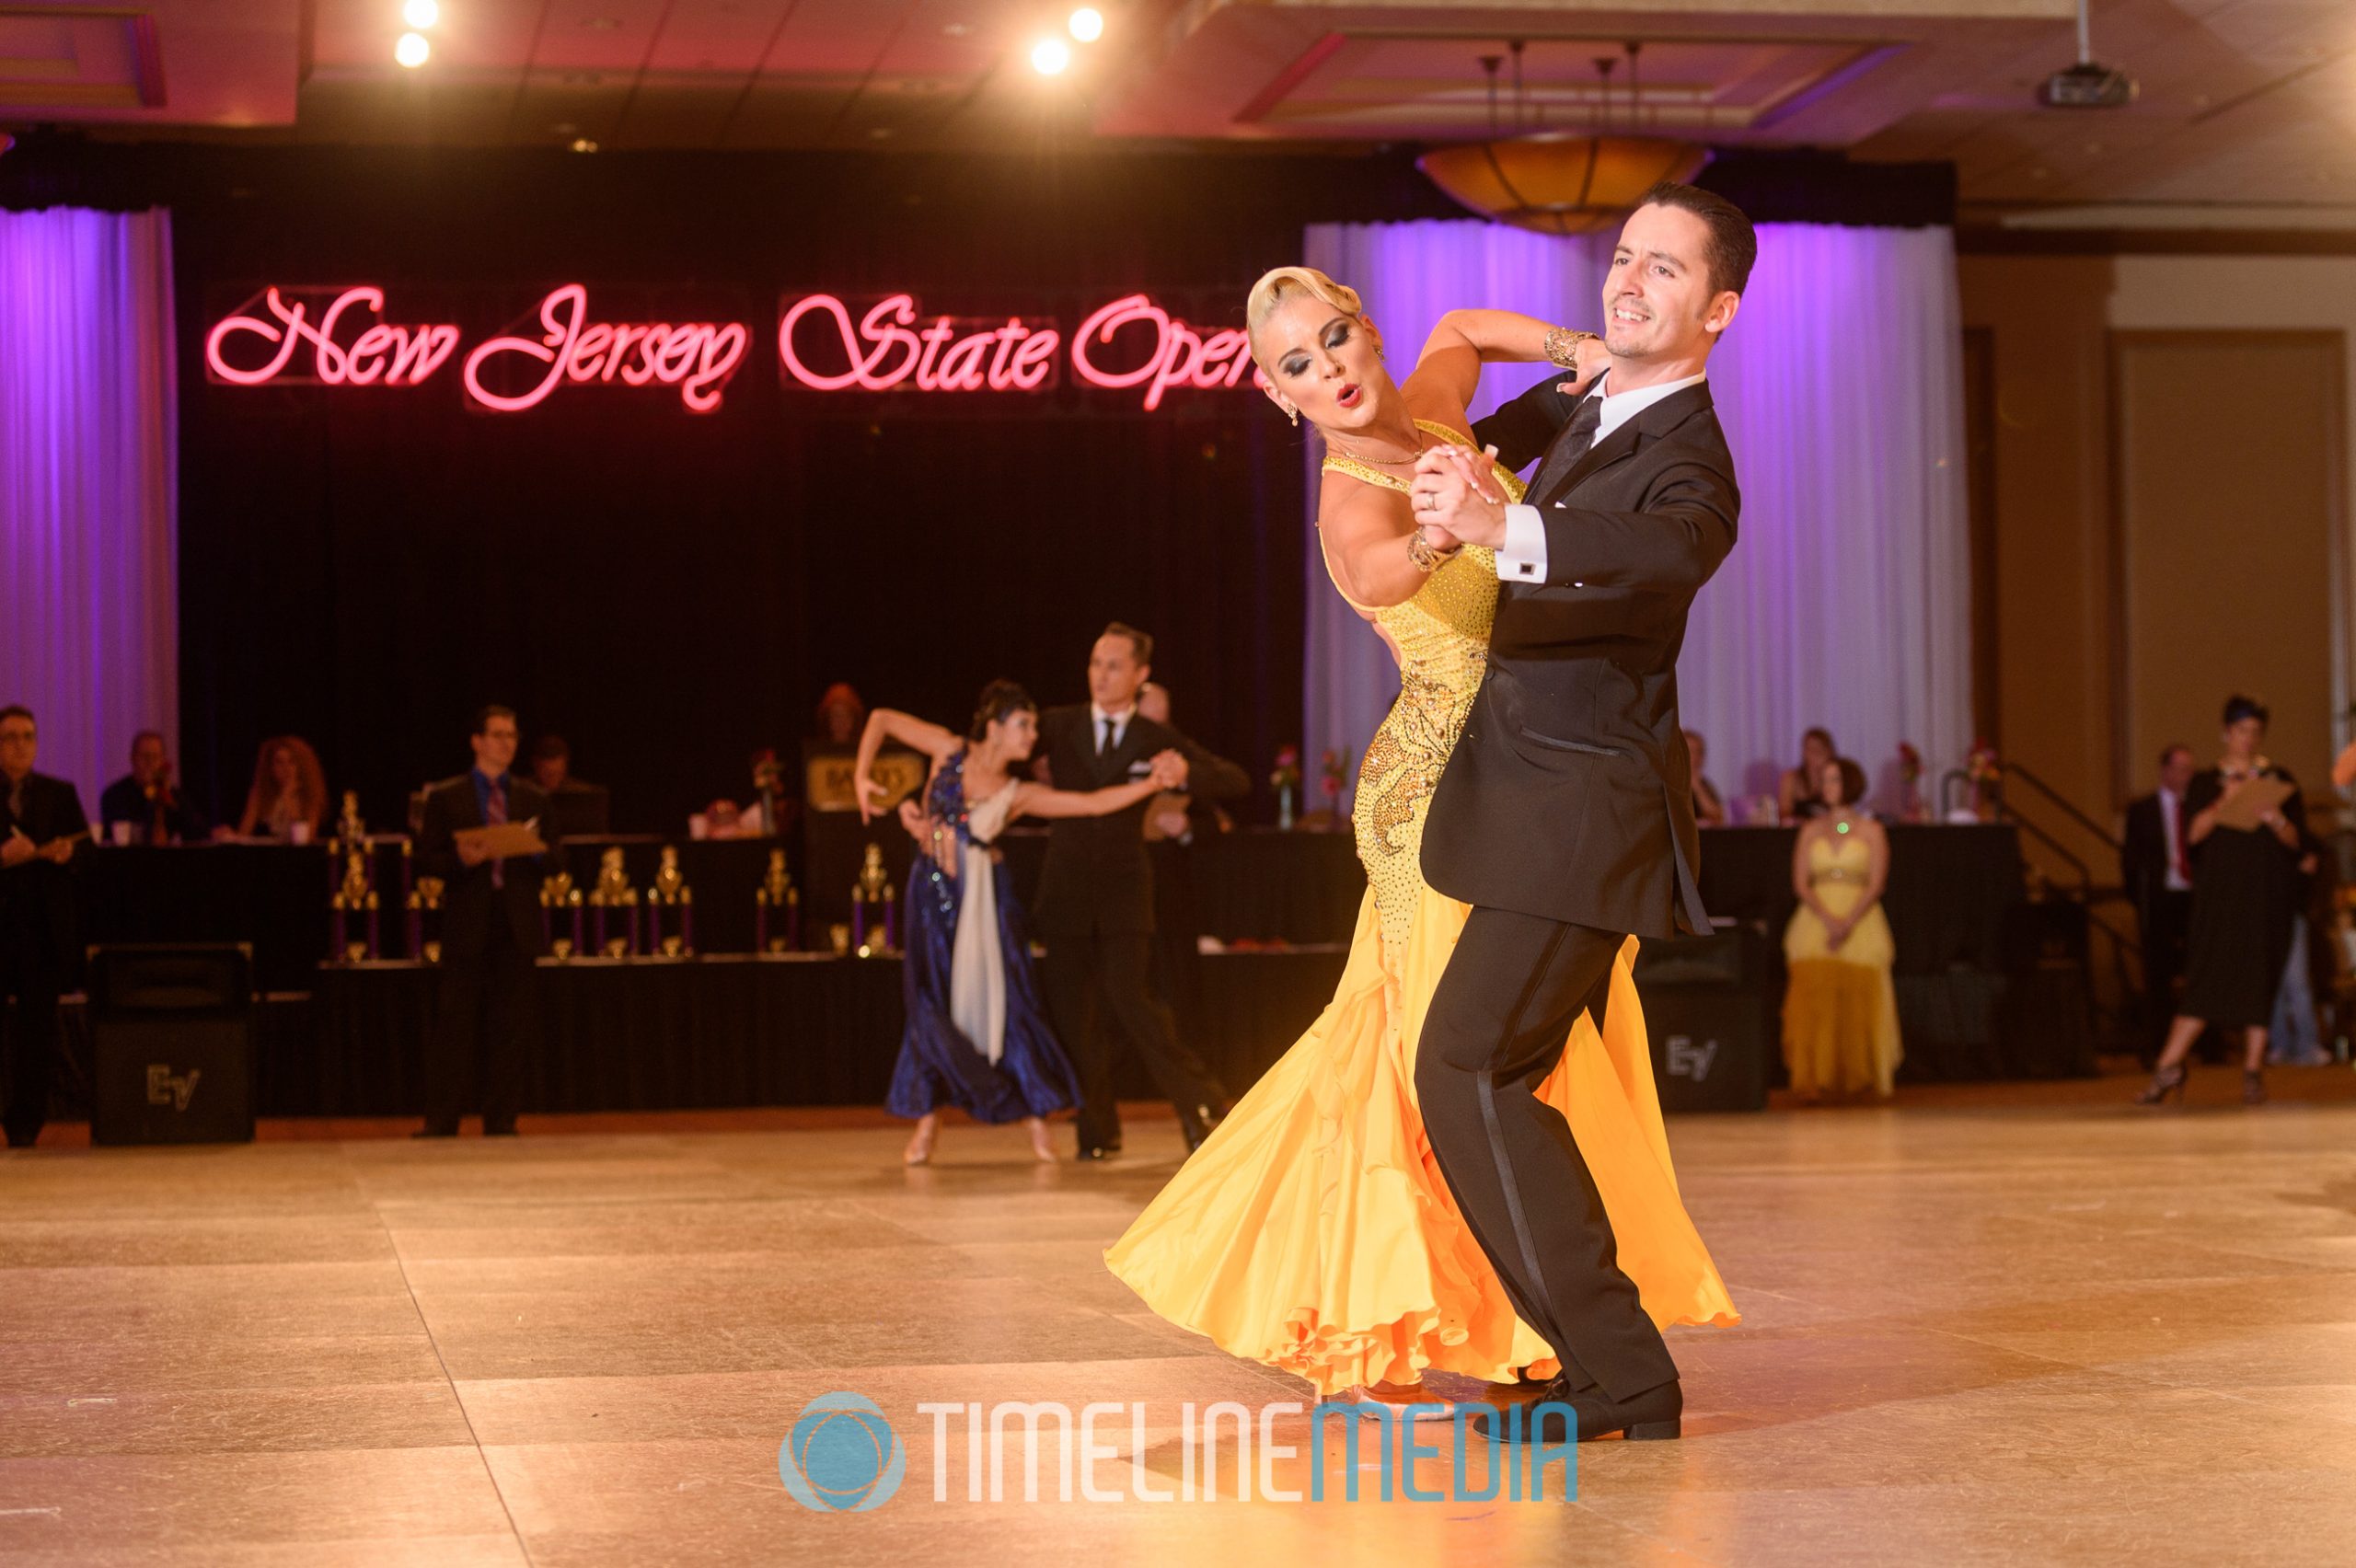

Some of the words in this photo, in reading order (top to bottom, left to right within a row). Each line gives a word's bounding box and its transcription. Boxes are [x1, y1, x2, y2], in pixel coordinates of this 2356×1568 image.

[206, 286, 459, 386] New
[464, 284, 746, 412] Jersey
[779, 294, 1059, 391] State
